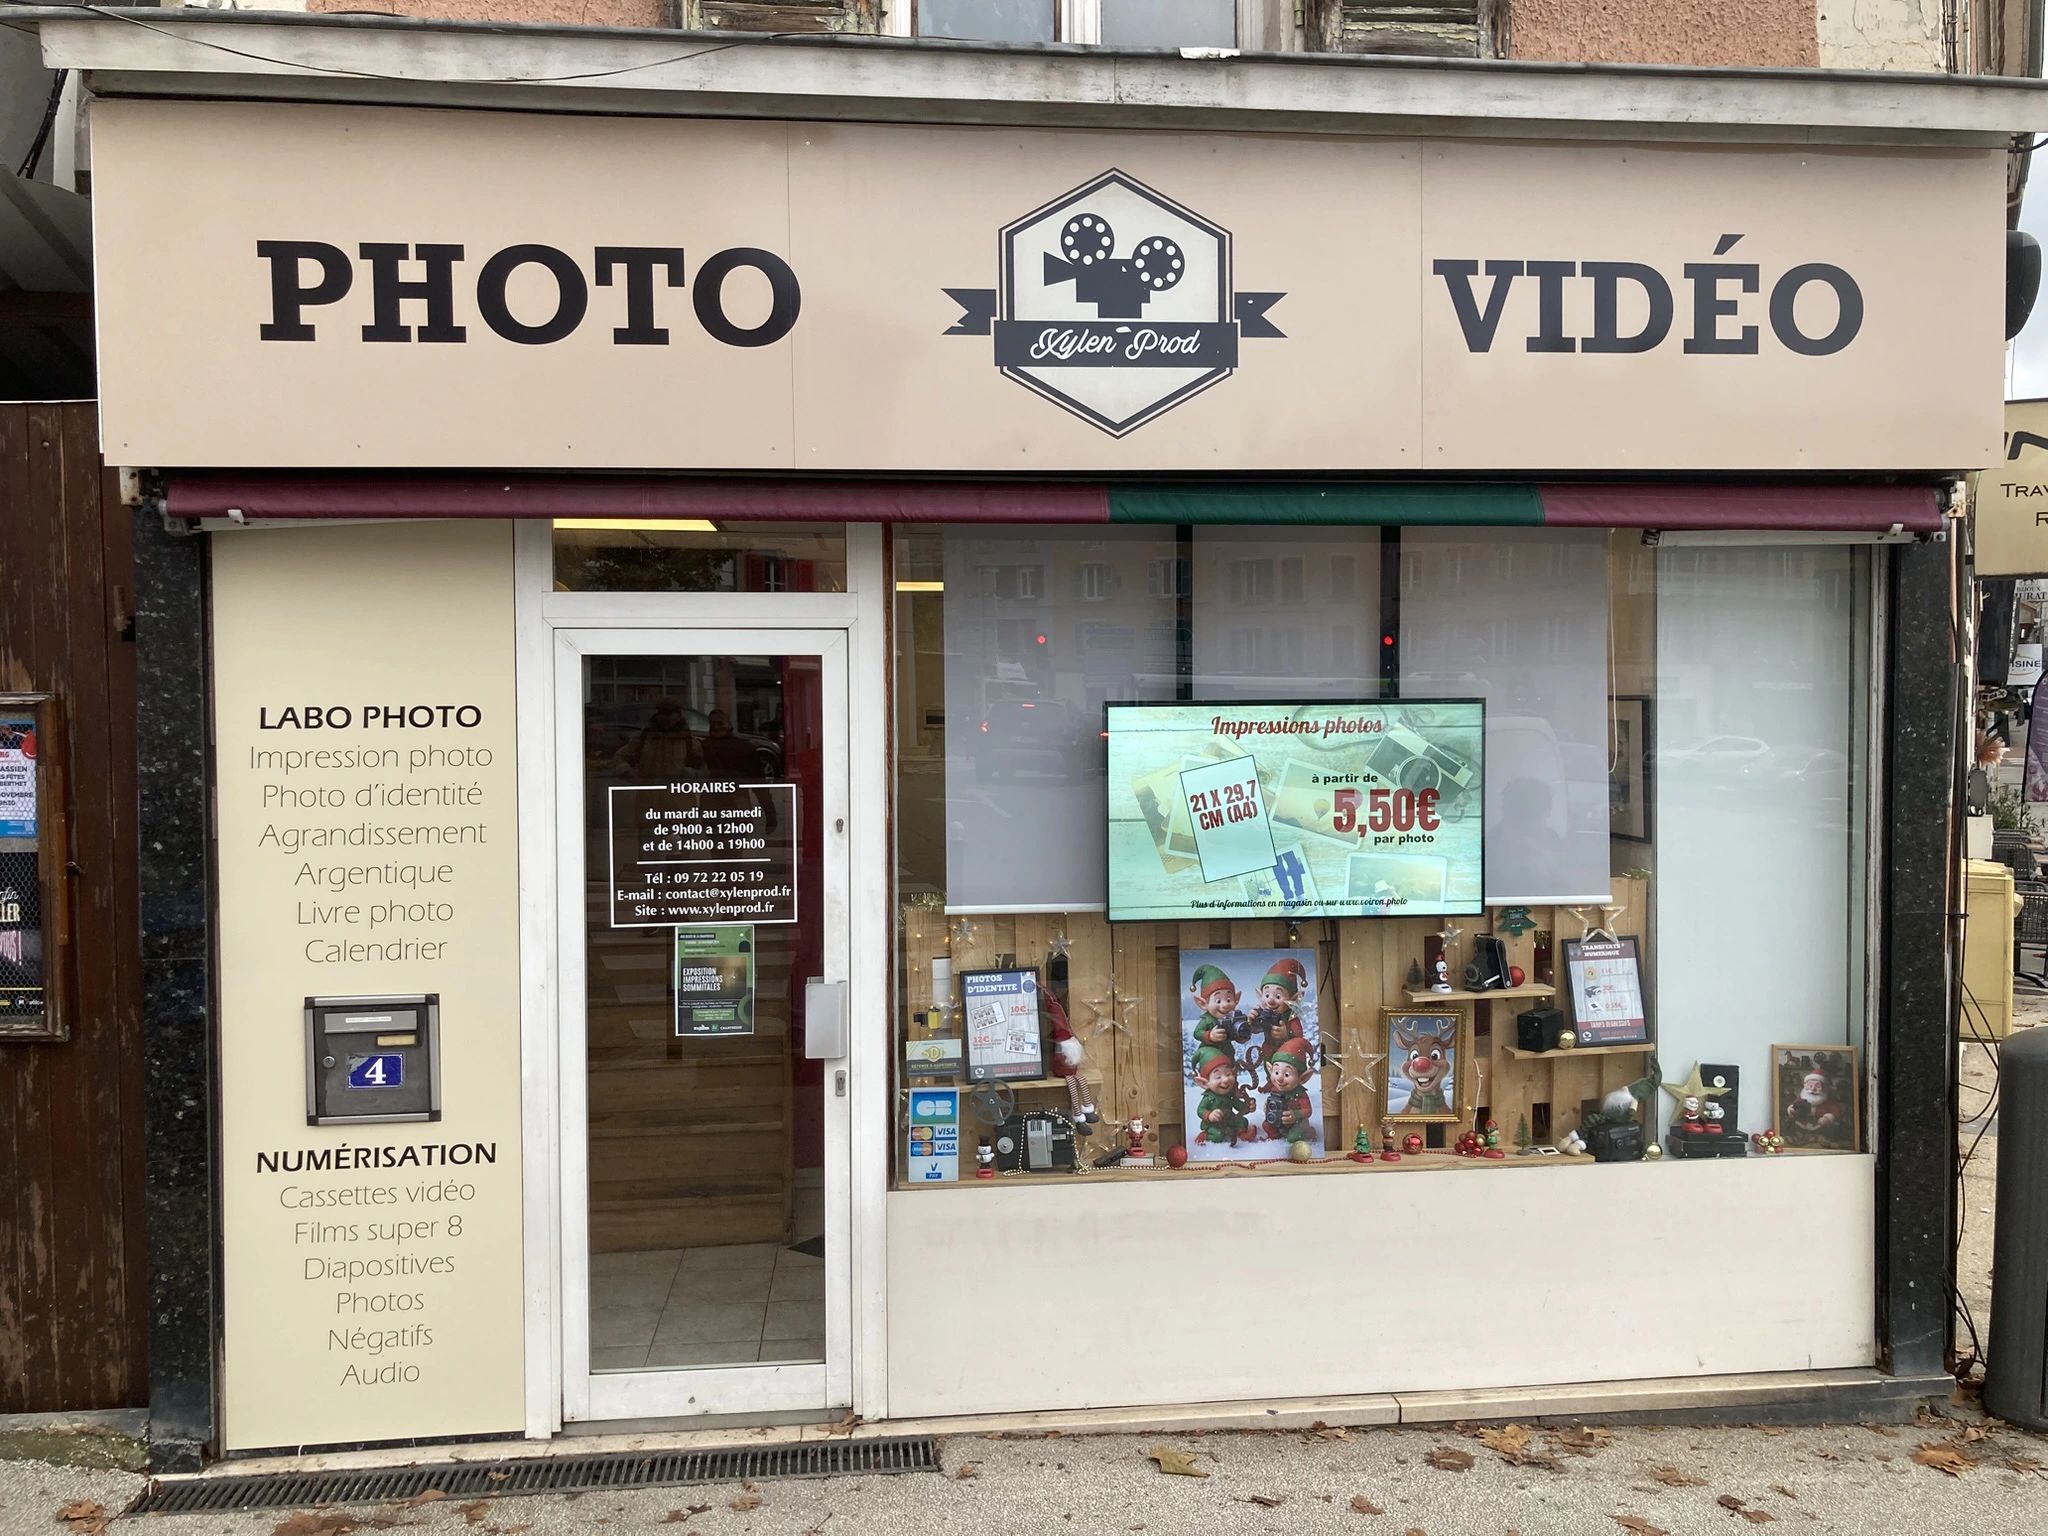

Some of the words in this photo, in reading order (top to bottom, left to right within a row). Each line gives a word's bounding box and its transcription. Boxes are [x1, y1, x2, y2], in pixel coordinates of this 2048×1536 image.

[256, 239, 802, 347] PHOTO
[1432, 233, 1865, 356] VIDÉO
[1030, 327, 1117, 360] Xylen
[1125, 328, 1201, 360] Prod
[259, 706, 352, 730] LABO
[362, 704, 483, 729] PHOTO
[1211, 715, 1321, 740] Impressions
[1322, 716, 1385, 739] photos
[250, 745, 400, 775] Impression
[409, 744, 494, 774] photo
[670, 782, 736, 794] HORAIRES
[1311, 773, 1319, 783] à
[1323, 773, 1359, 786] partir
[1363, 773, 1378, 783] de
[263, 784, 346, 808] Photo
[354, 781, 484, 807] d'identité
[1190, 792, 1208, 813] 21
[1209, 789, 1222, 808] X
[1223, 779, 1256, 805] 29,7
[645, 808, 661, 820] du
[664, 807, 699, 820] mardi
[702, 809, 717, 819] au
[720, 806, 762, 819] samedi
[1199, 808, 1225, 831] CM
[1226, 800, 1259, 824] (A4)
[1332, 787, 1441, 838] 5,50€
[258, 822, 488, 854] Agrandissement
[653, 824, 669, 836] de
[671, 823, 703, 835] 9h00
[705, 825, 713, 834] a
[716, 822, 754, 834] 12h00
[1374, 835, 1395, 846] par
[1398, 833, 1435, 845] photo
[642, 840, 655, 852] et
[658, 839, 673, 851] de
[676, 838, 714, 850] 14h00
[717, 841, 724, 850] a
[728, 838, 766, 850] 19h00
[294, 860, 454, 893] Argentique
[645, 872, 663, 884] Tél
[674, 872, 689, 884] 09
[693, 872, 708, 883] 72
[711, 871, 727, 883] 22
[730, 871, 745, 882] 05
[749, 870, 764, 882] 19
[617, 888, 655, 901] E-mail
[665, 885, 792, 901] contact@xylenprod.fr
[1190, 899, 1208, 909] Plus
[1208, 899, 1266, 911] d'informations
[1267, 900, 1277, 908] en
[1278, 899, 1313, 910] magasin
[1314, 899, 1324, 907] ou
[1324, 899, 1338, 907] sur
[297, 901, 361, 925] Livre
[370, 899, 454, 930] photo
[634, 903, 657, 917] Site
[667, 901, 775, 918] www.xylenprod.fr
[305, 937, 448, 963] Calendrier
[683, 975, 723, 983] IMPRESSIONS
[683, 983, 720, 991] SOMMITALES
[966, 974, 1003, 984] PHOTOS
[967, 983, 1018, 994] D'IDENTITE
[364, 1057, 387, 1085] 4
[937, 1127, 956, 1136] VISA
[256, 1142, 497, 1173] NUMÉRISATION
[937, 1142, 956, 1151] VISA
[279, 1183, 398, 1210] Cassettes
[405, 1179, 476, 1204] vidéo
[294, 1220, 359, 1245] Films
[367, 1217, 440, 1246] super
[446, 1214, 463, 1237] 8
[303, 1253, 456, 1283] Diapositives
[336, 1291, 425, 1315] Photos
[328, 1324, 434, 1356] Négatifs
[340, 1362, 421, 1387] Audio
